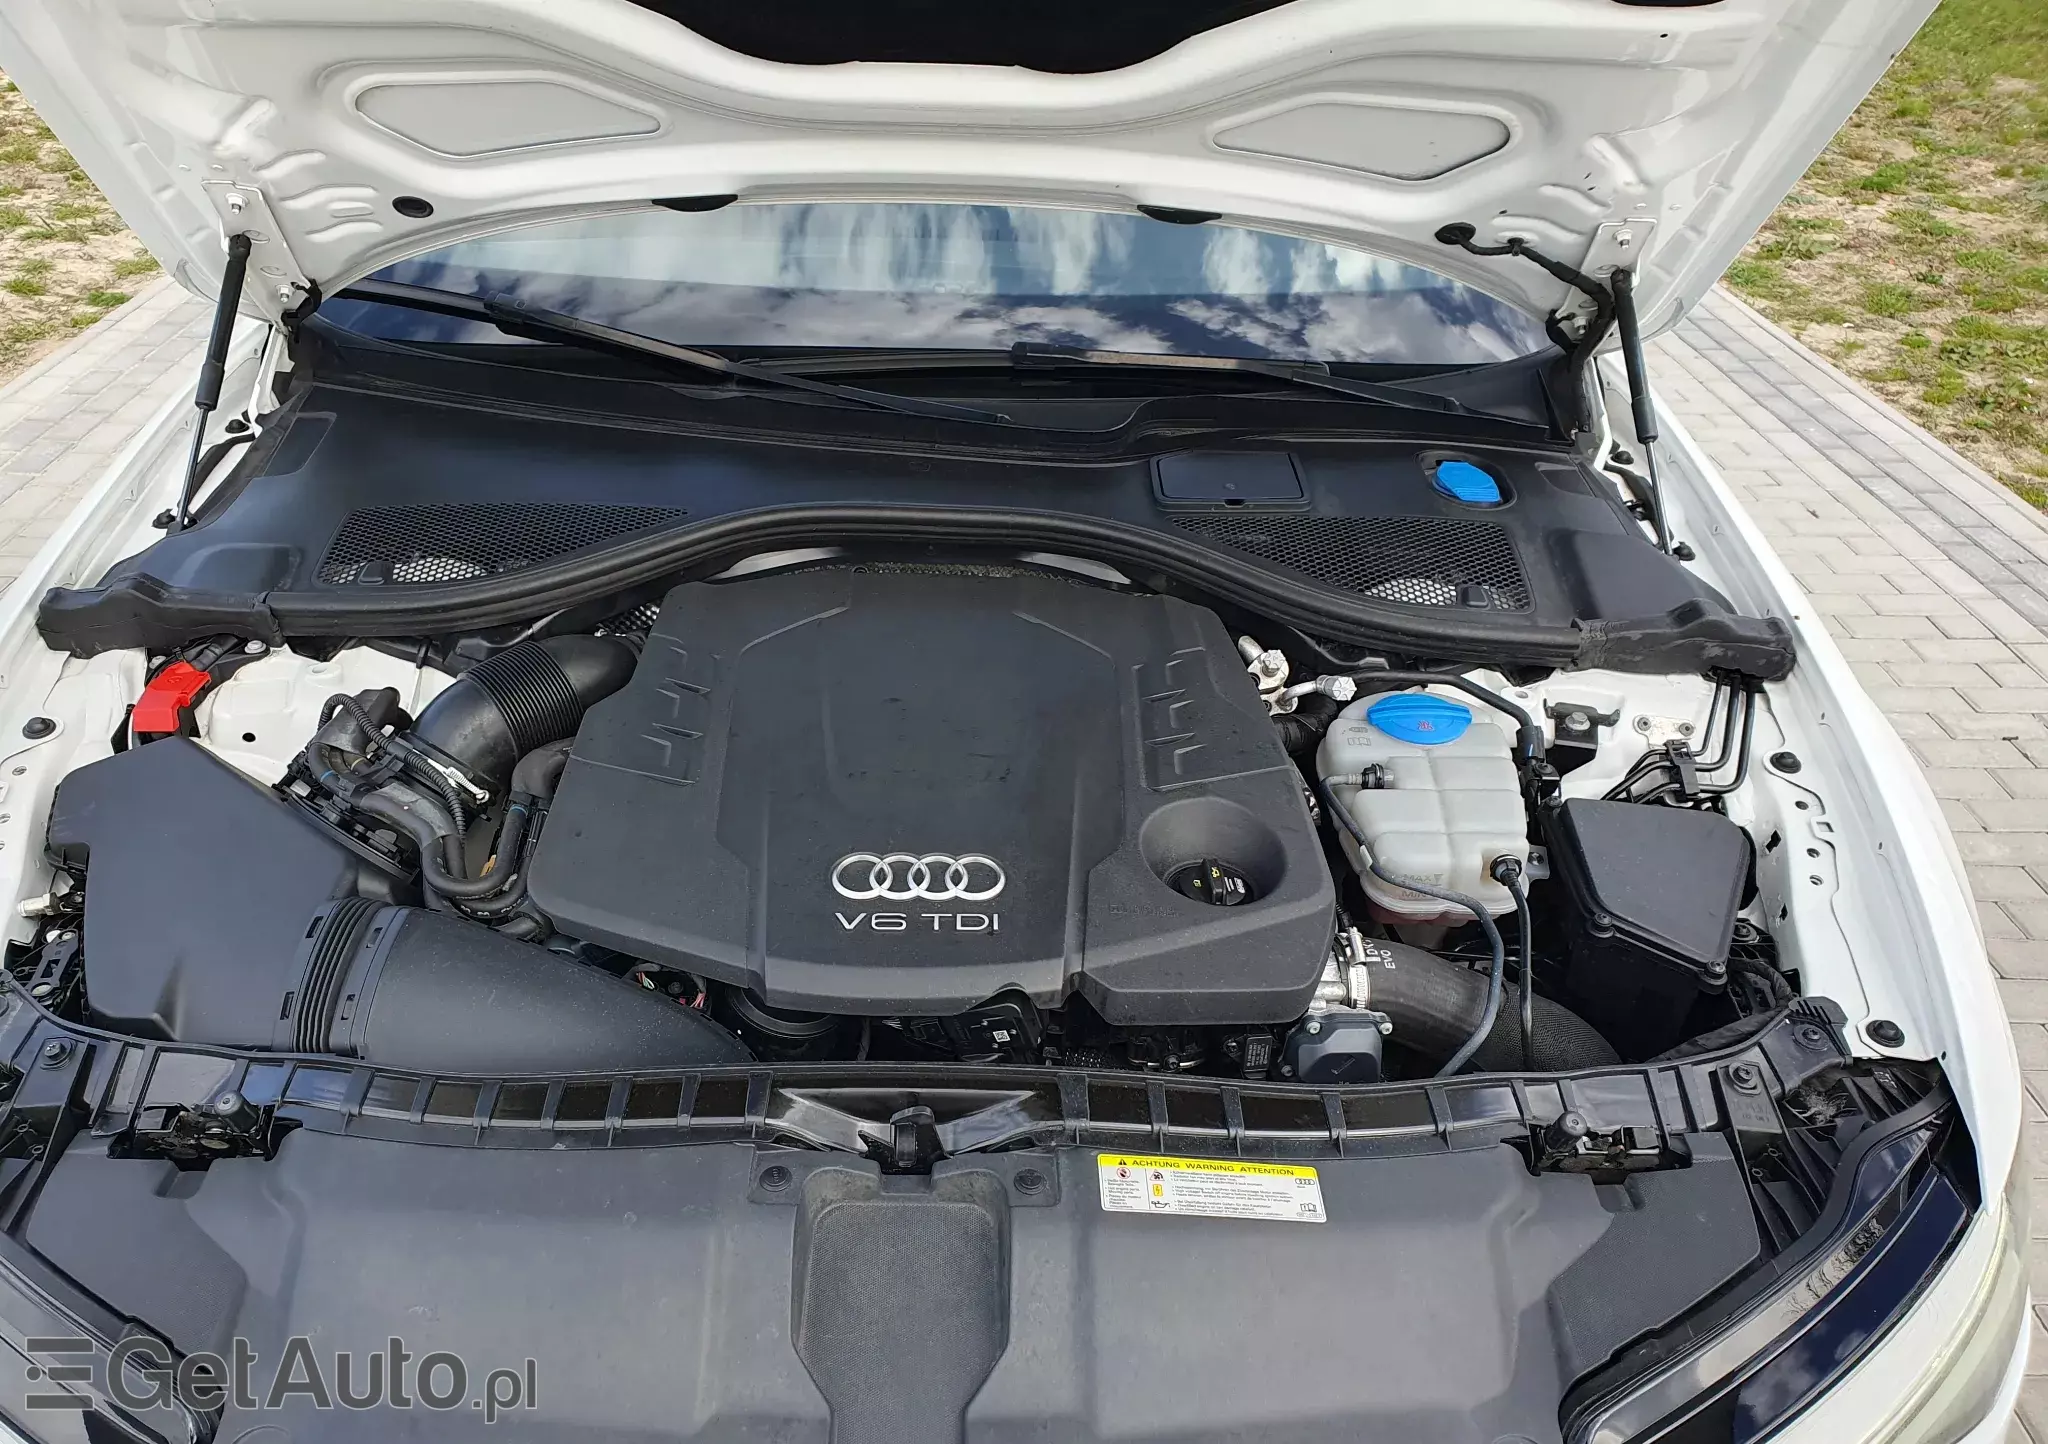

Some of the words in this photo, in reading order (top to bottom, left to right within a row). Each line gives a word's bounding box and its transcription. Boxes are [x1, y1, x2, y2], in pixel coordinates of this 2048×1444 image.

[835, 912, 907, 931] V6
[921, 913, 999, 931] TDI
[1380, 949, 1396, 970] EVO
[1132, 1159, 1180, 1169] ACHTUNG
[1185, 1162, 1235, 1173] WARNING
[1240, 1165, 1295, 1176] ATTENTION
